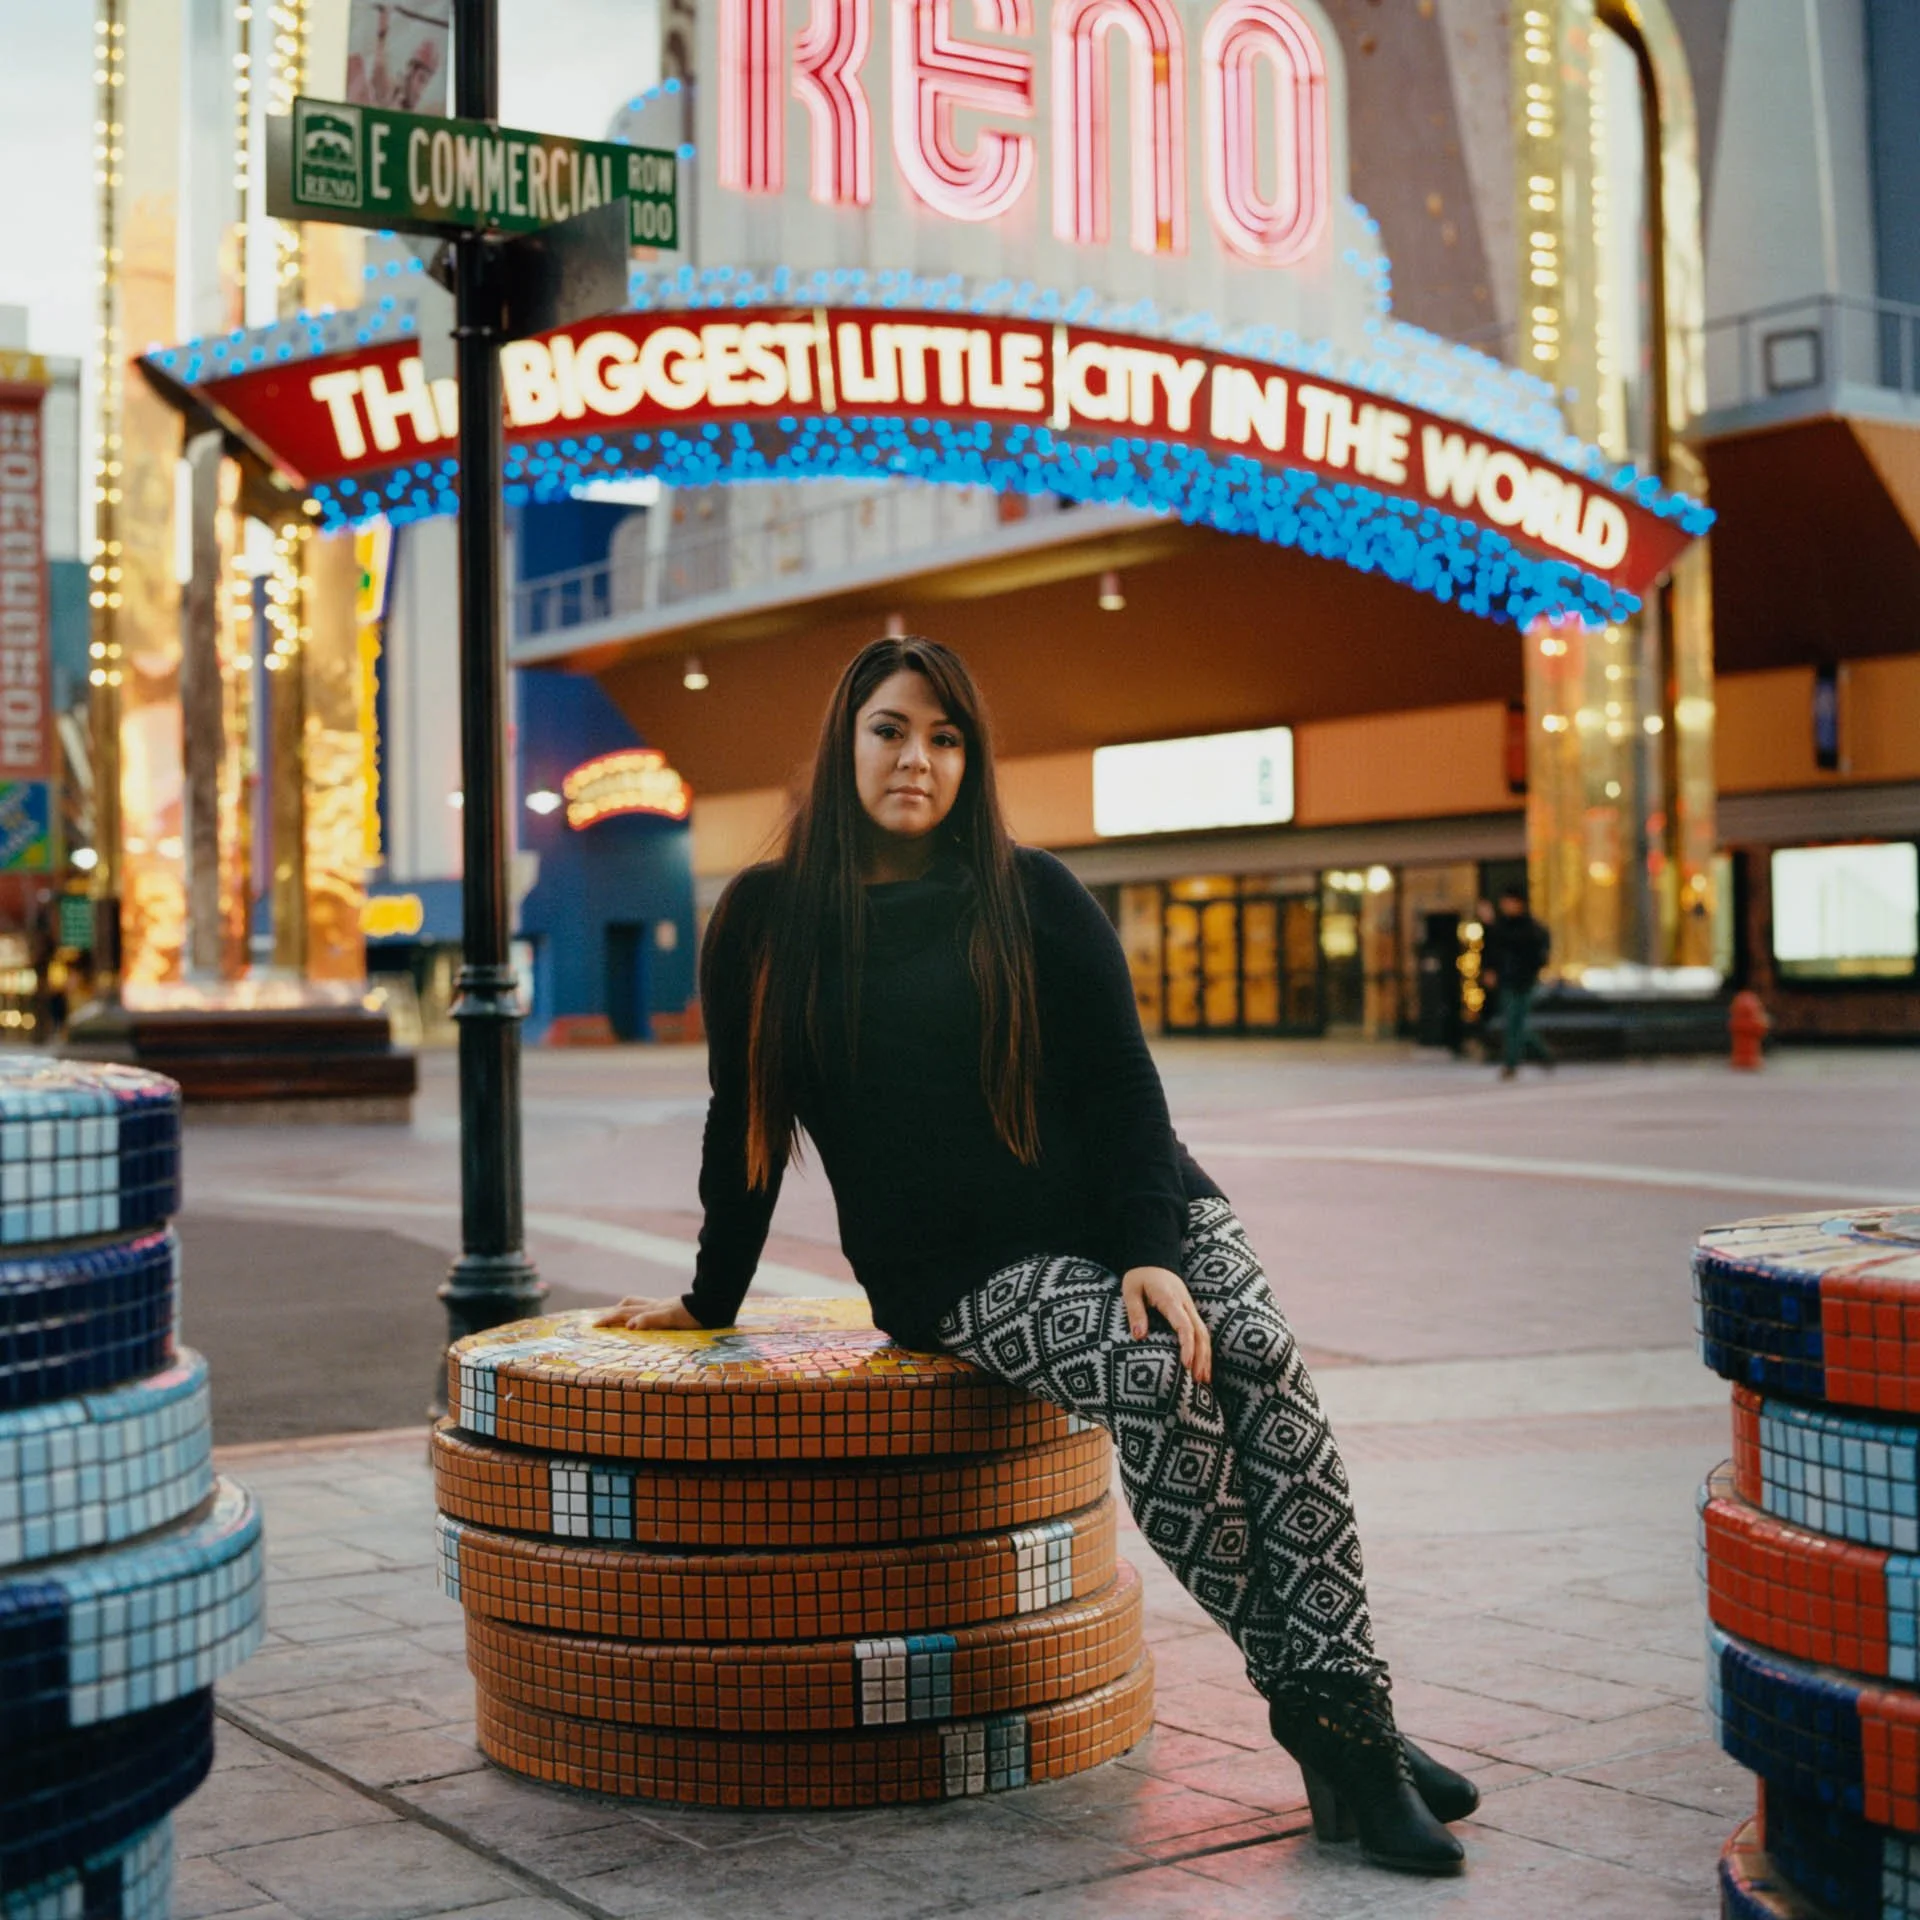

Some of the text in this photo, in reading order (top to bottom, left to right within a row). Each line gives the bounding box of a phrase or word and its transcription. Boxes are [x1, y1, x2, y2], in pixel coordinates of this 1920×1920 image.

[370, 122, 391, 199] E
[628, 153, 673, 196] ROW
[718, 0, 1328, 266] RENO
[304, 174, 357, 202] RENO
[632, 200, 673, 241] 100
[500, 322, 818, 427] BIGGEST
[837, 323, 1045, 412] LITTLE
[1068, 342, 1206, 432] CITY
[1210, 365, 1288, 452] IN
[1298, 384, 1412, 485] THE
[1421, 424, 1629, 569] WORLD
